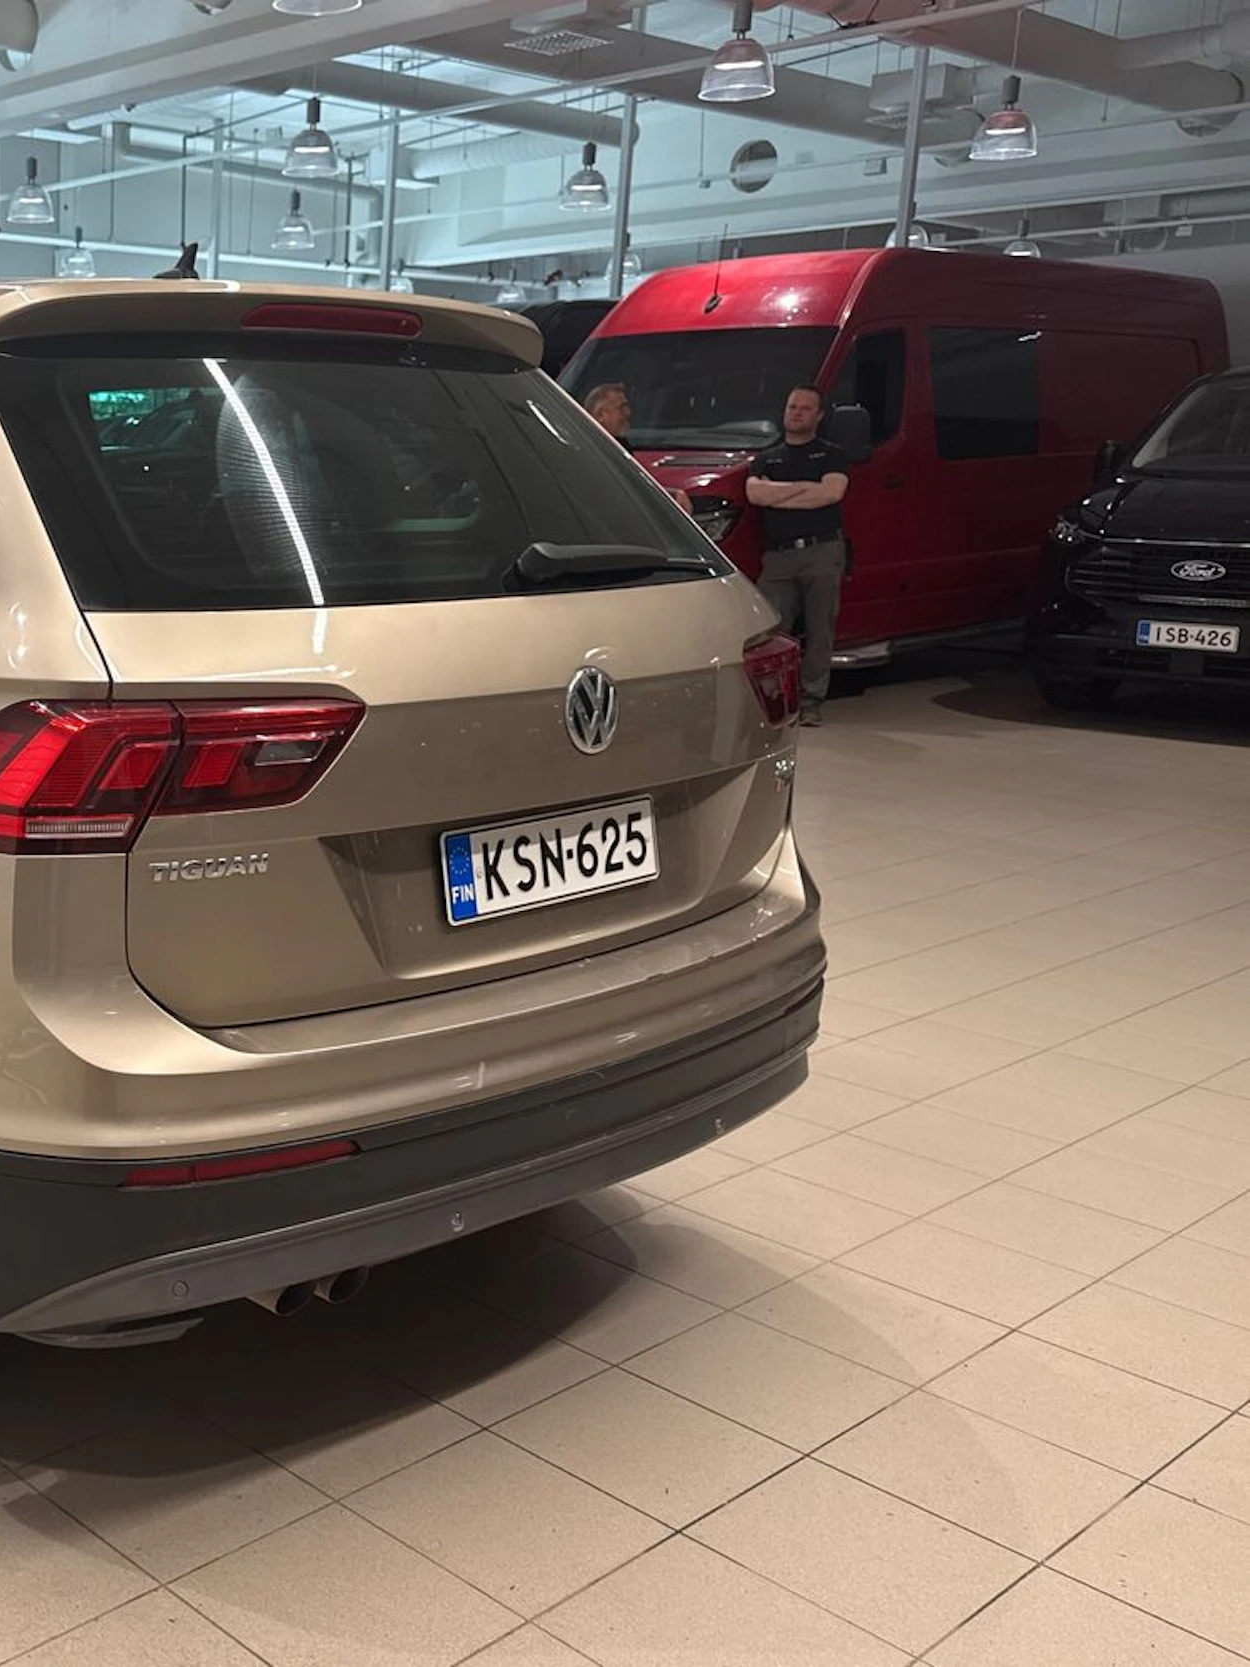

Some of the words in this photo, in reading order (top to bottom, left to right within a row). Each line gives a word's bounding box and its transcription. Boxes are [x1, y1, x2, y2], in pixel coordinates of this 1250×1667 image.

[1175, 562, 1223, 579] Ford
[1156, 627, 1232, 647] ISB-426
[482, 812, 647, 900] KSN-625
[149, 853, 269, 881] TIGUAN
[451, 883, 475, 904] FIN
